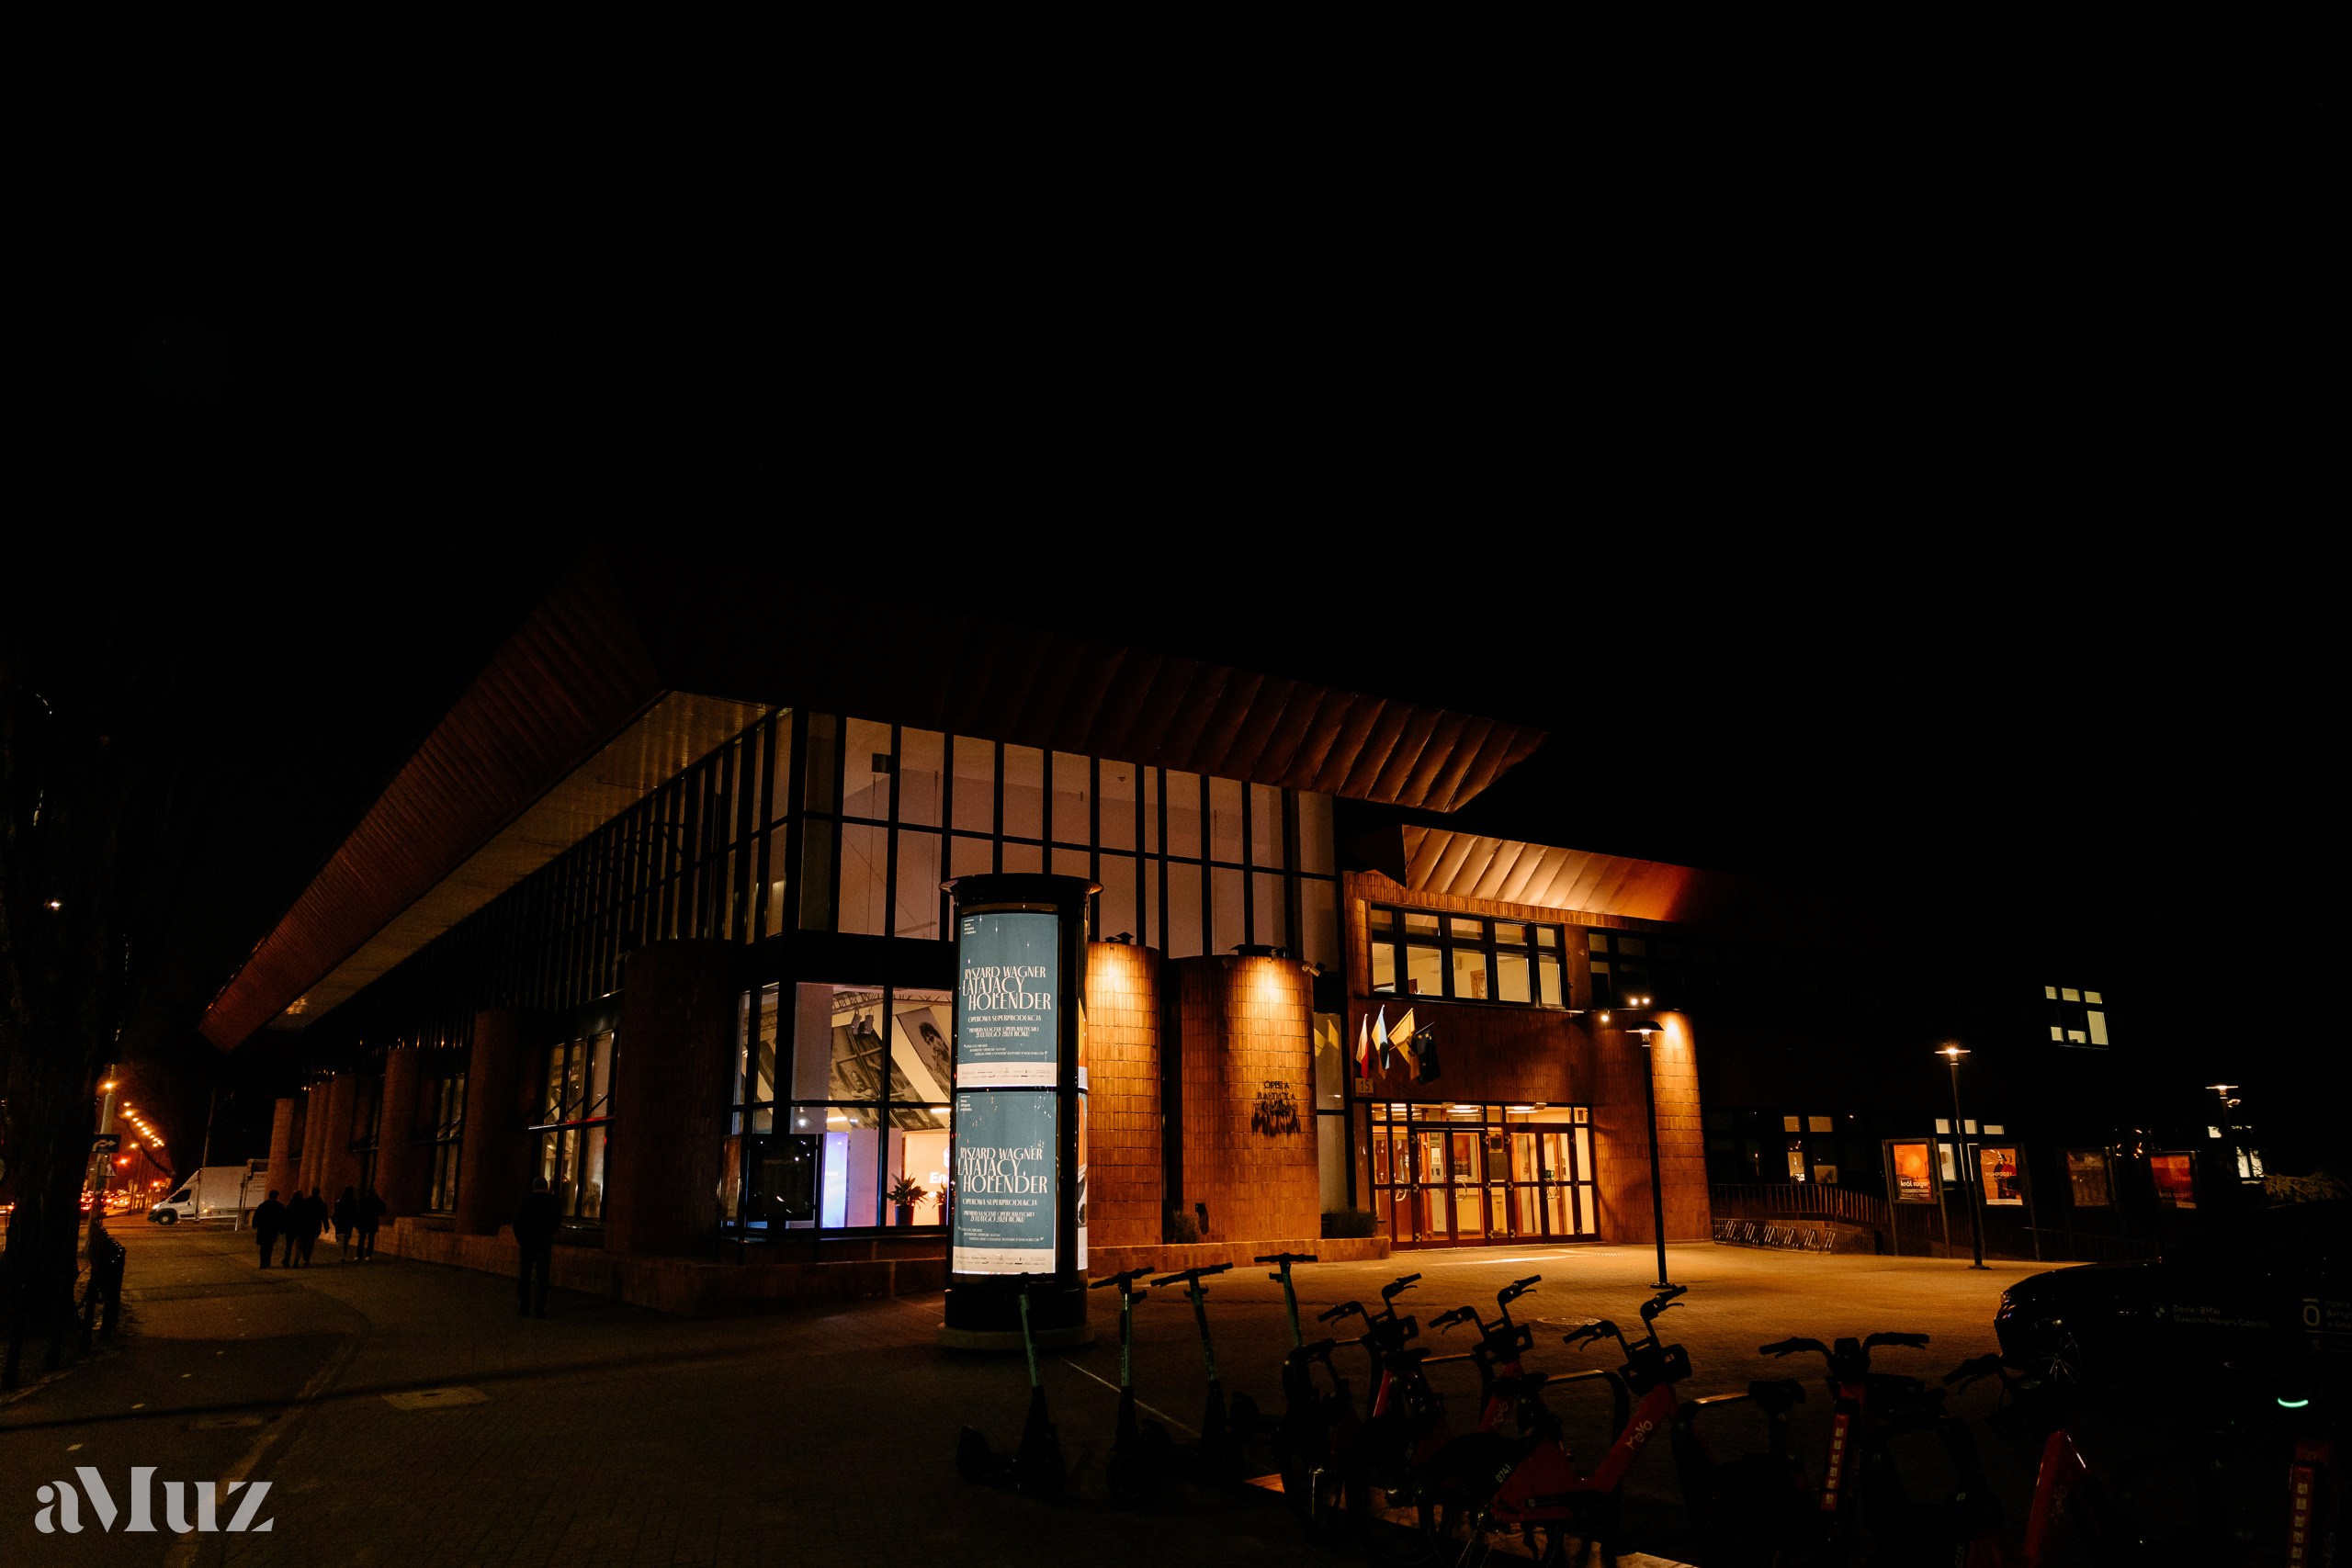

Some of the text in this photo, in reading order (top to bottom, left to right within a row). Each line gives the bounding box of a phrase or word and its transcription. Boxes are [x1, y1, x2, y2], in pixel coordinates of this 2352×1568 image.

[965, 965, 1046, 980] RYSZARD WAGNER
[968, 992, 1051, 1011] HOLENDER
[991, 1014, 1042, 1022] SUPERPRODUKCJA
[960, 1147, 1043, 1161] RYSZARD WAGNER
[929, 1172, 949, 1184] En
[963, 1175, 1047, 1194] HOLENDER
[987, 1198, 1037, 1206] SUPERPRODUKCJA
[2199, 1306, 2221, 1315] BMW
[1494, 1463, 1513, 1483] 0741
